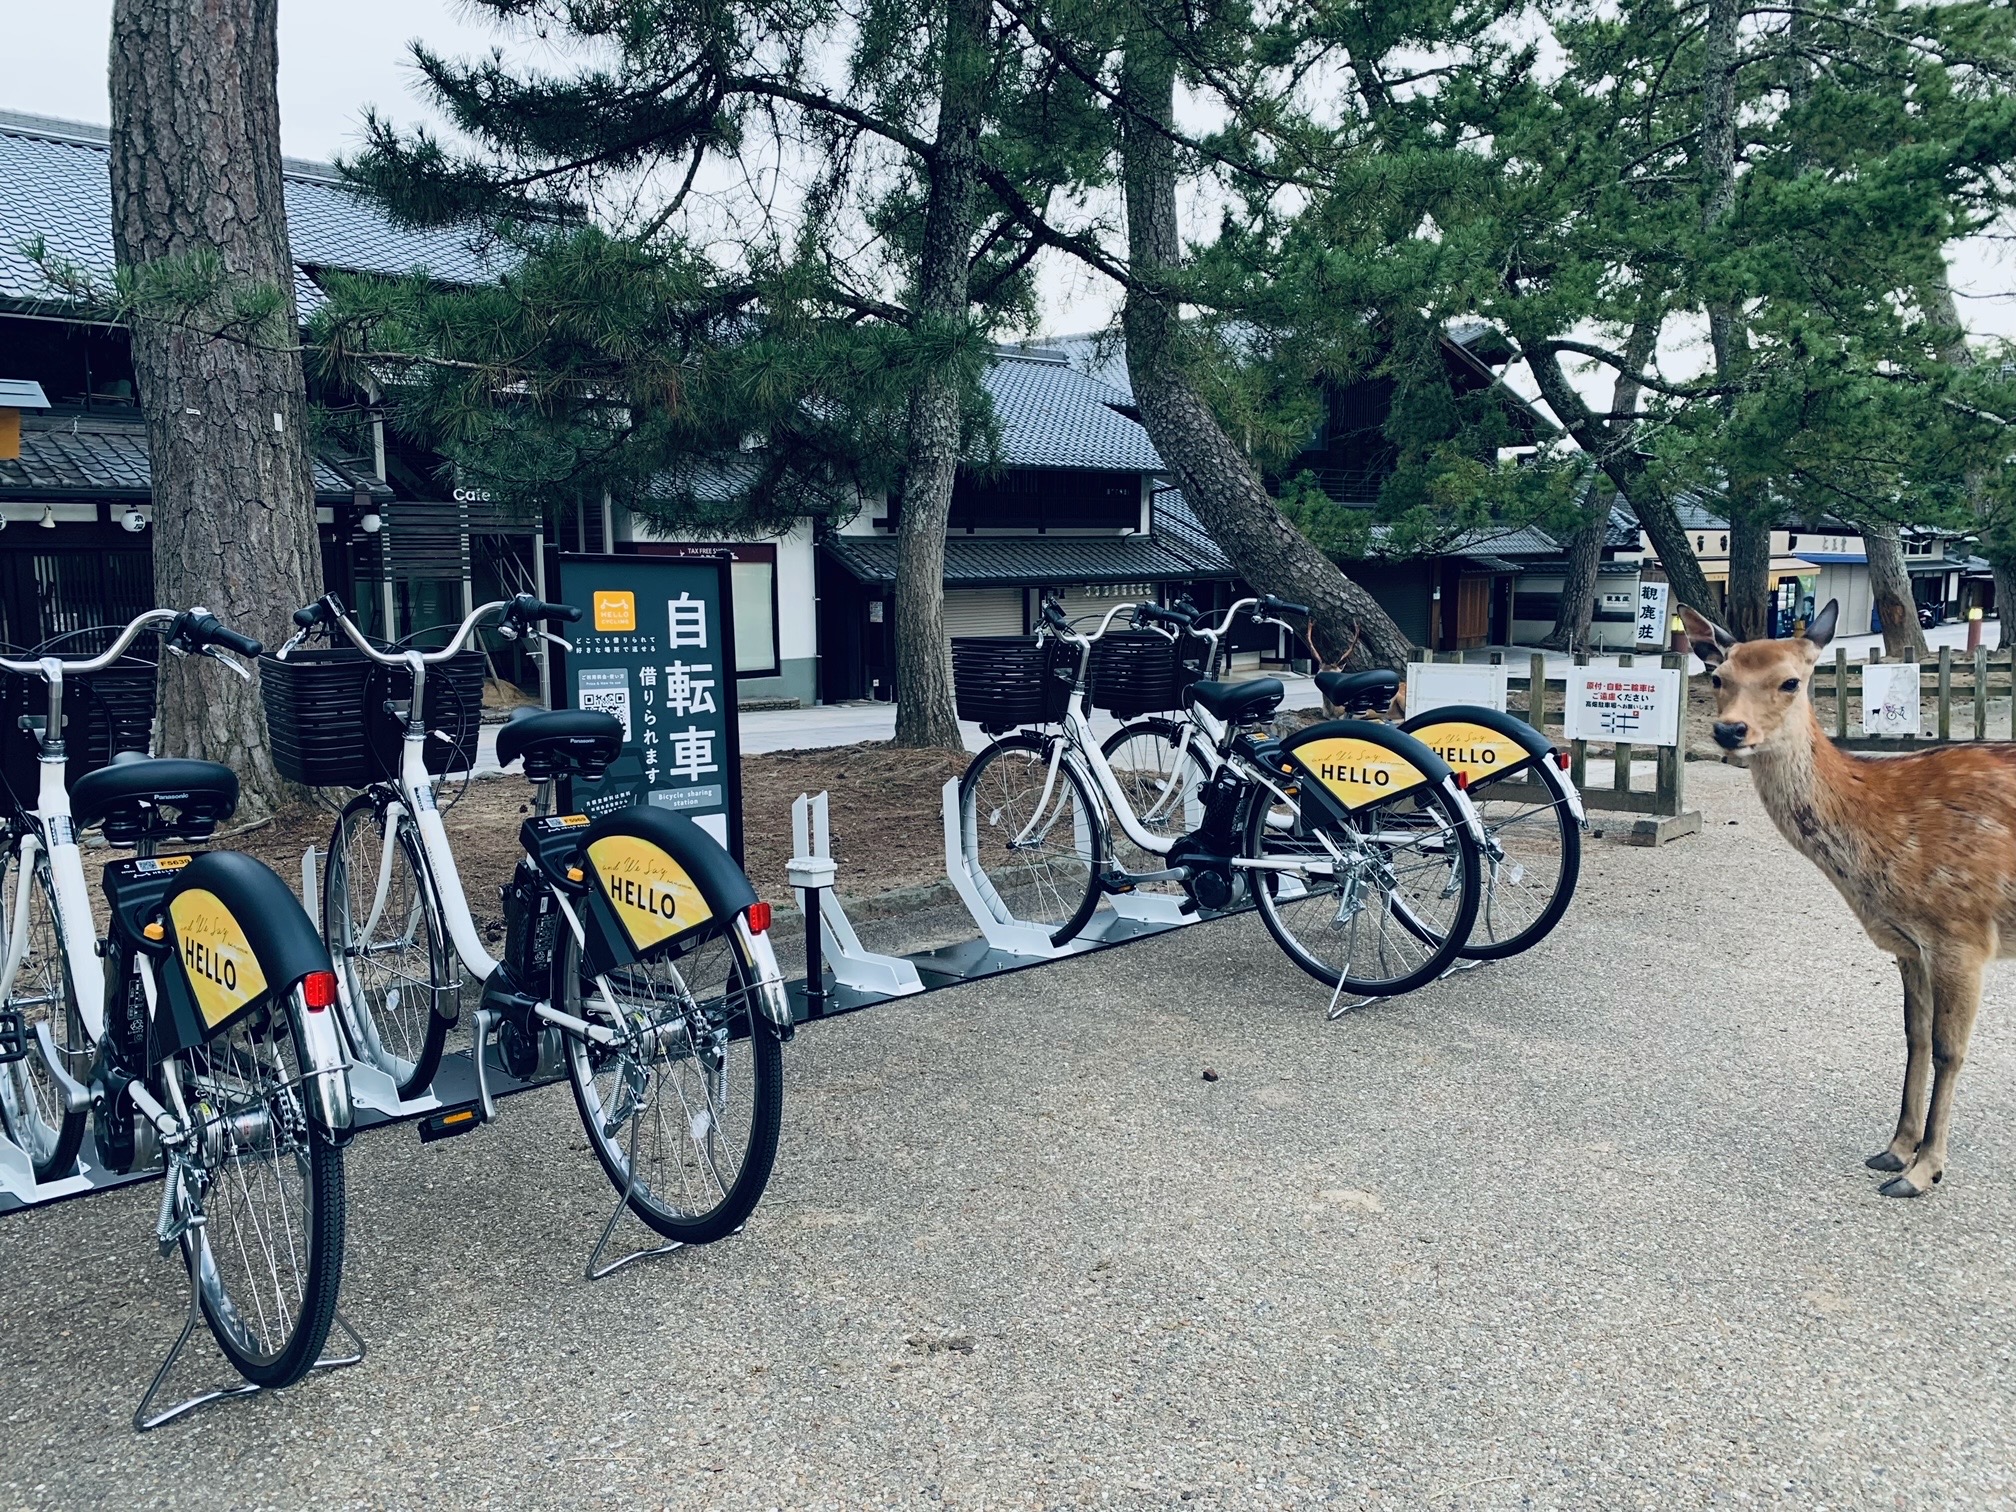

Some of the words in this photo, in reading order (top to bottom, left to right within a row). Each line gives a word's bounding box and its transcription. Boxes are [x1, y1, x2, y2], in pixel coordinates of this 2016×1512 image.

[576, 636, 656, 645] どこでも借りられて
[576, 646, 656, 654] 好きな場所で返せる
[665, 591, 719, 782] 自転車
[1586, 681, 1655, 692] 原付・自動二輪車は
[1592, 691, 1649, 702] ご遠慮ください
[1585, 700, 1655, 711] 高畑駐車場へお願いします
[639, 666, 660, 784] 借りられます
[1433, 747, 1496, 764] HELLO
[1321, 763, 1389, 786] HELLO
[658, 791, 683, 801] Bicycle
[687, 789, 712, 797] sharing
[673, 799, 699, 807] station
[602, 861, 621, 871] and
[624, 857, 640, 872] We
[644, 859, 667, 880] Say
[611, 874, 675, 919] HELLO
[185, 936, 236, 991] HELLO
